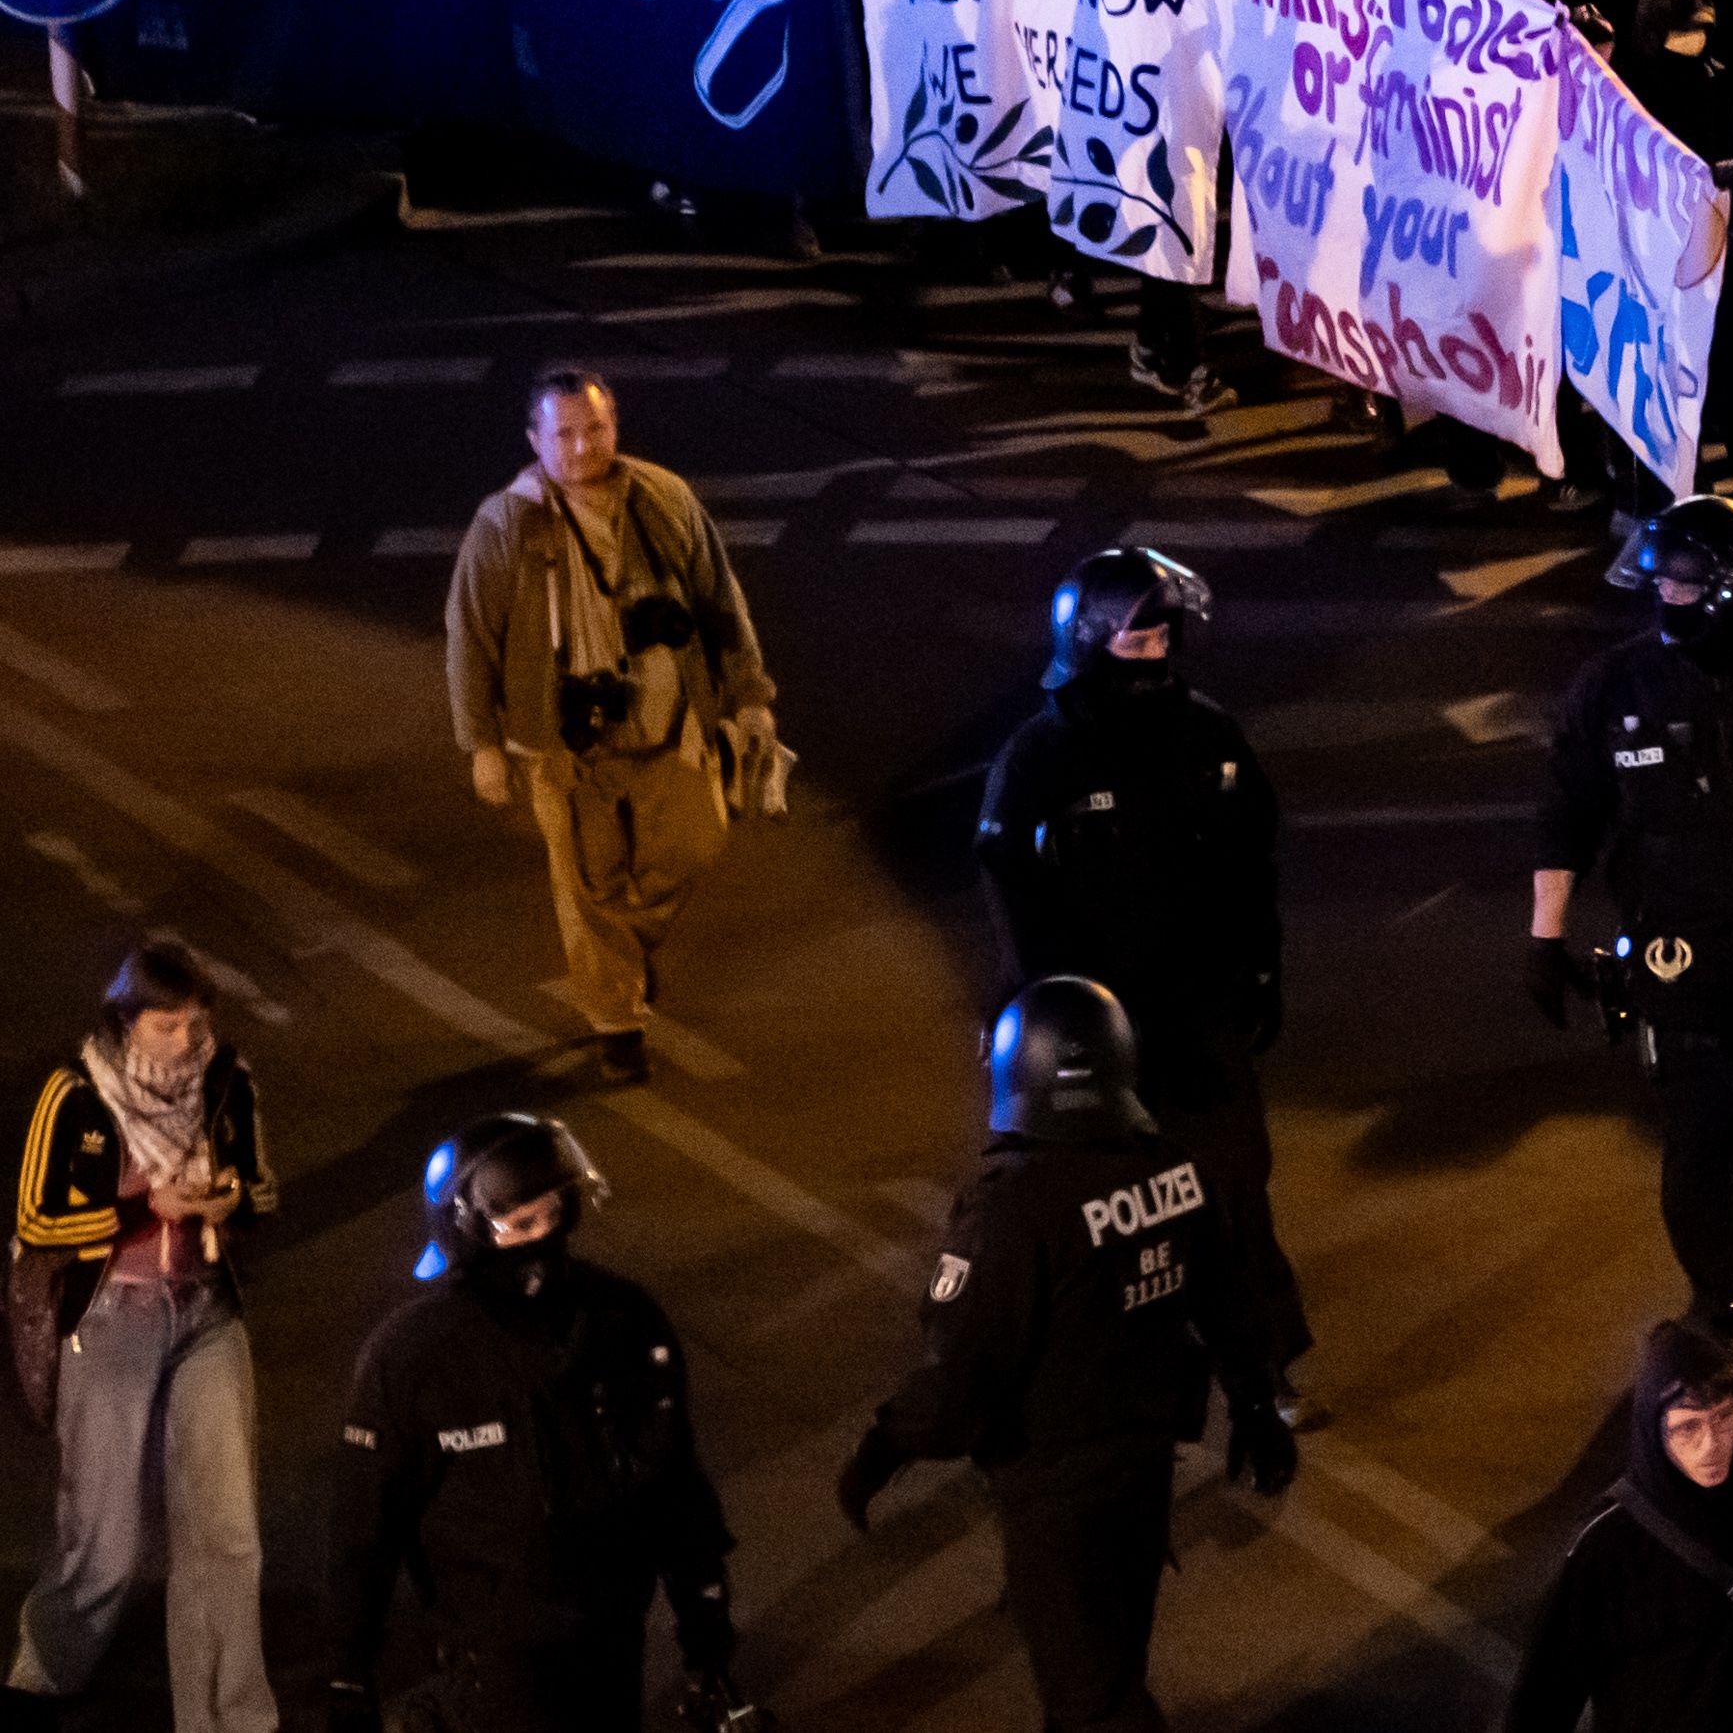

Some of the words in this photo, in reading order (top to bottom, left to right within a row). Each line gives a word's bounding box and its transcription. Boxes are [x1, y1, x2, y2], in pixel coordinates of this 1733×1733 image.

[919, 38, 992, 105] WE
[1293, 41, 1351, 124] or
[1359, 183, 1470, 299] your
[1613, 747, 1664, 768] POLIZEI
[1080, 1161, 1206, 1249] POLIZEI
[1138, 1239, 1173, 1275] BE
[437, 1421, 507, 1452] POLIZEI
